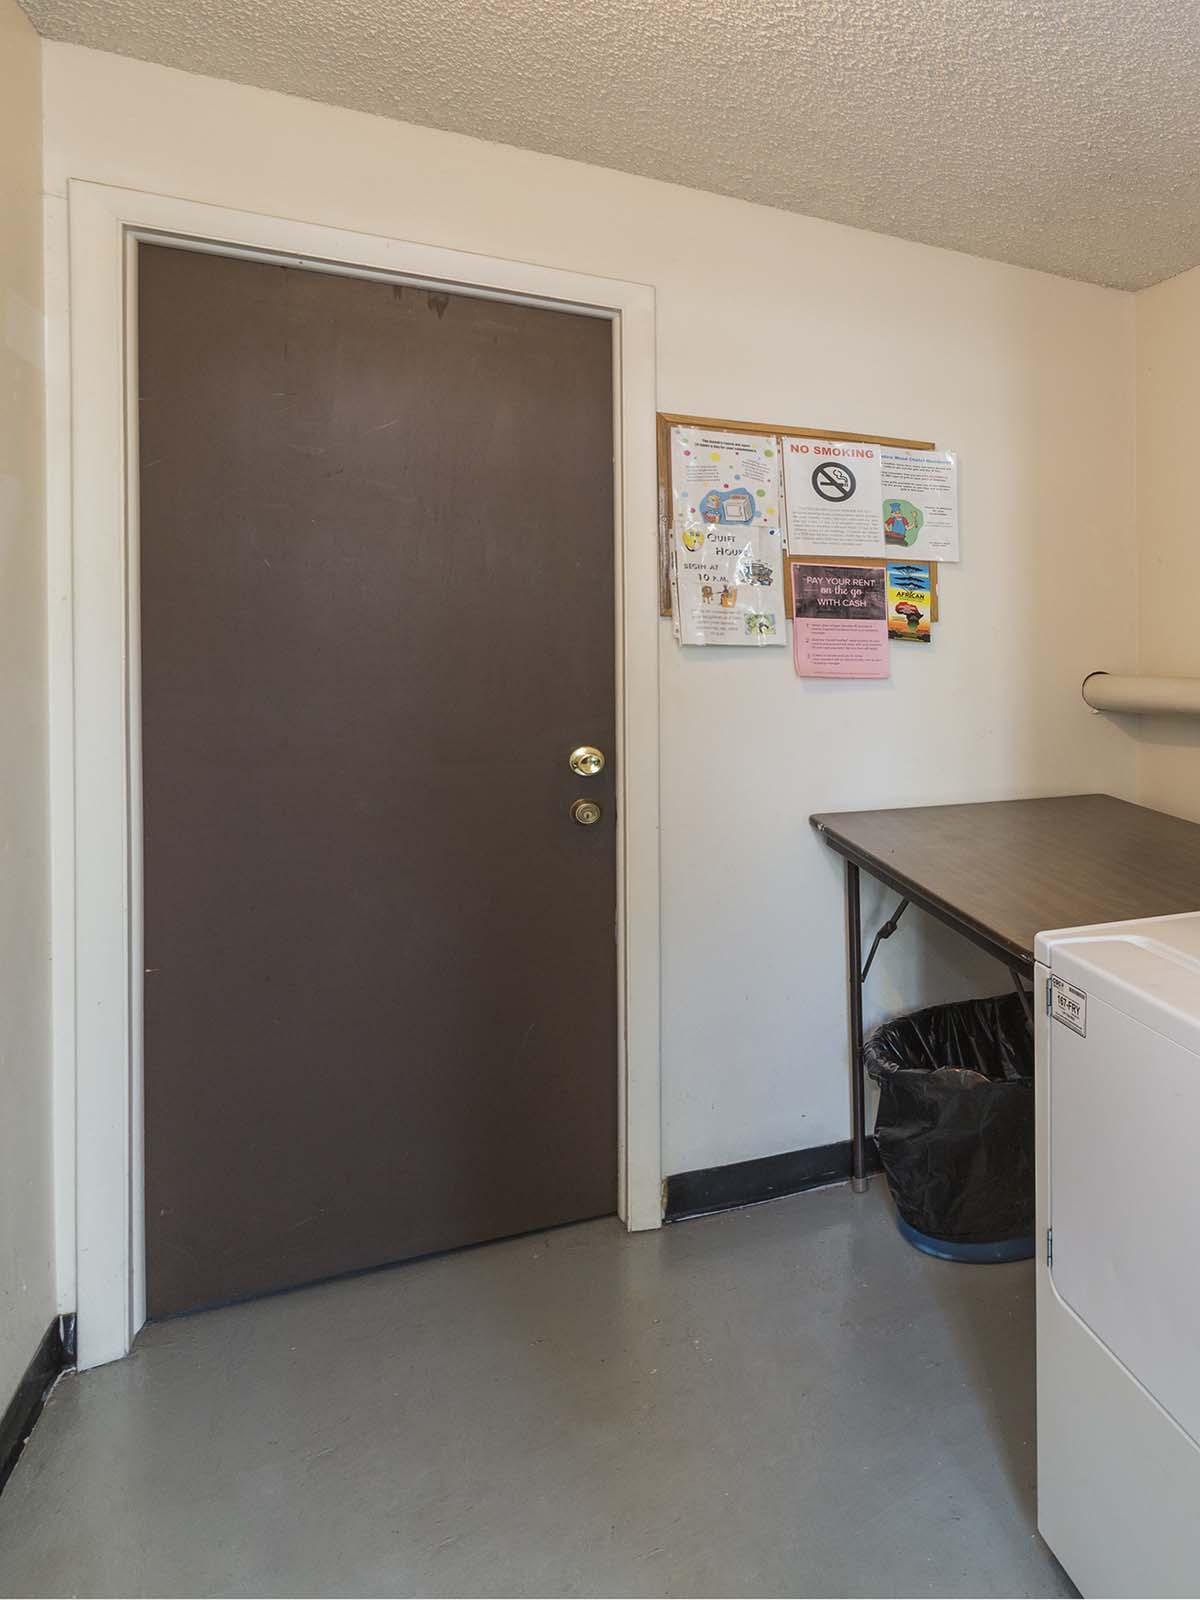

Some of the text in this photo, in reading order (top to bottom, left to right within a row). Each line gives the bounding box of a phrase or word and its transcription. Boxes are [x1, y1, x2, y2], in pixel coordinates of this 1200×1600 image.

[790, 444, 873, 458] NO SMOKING
[806, 576, 823, 584] PAY
[835, 586, 848, 594] the
[850, 589, 863, 597] go
[896, 591, 925, 600] AFRICAN
[842, 599, 867, 607] CASH
